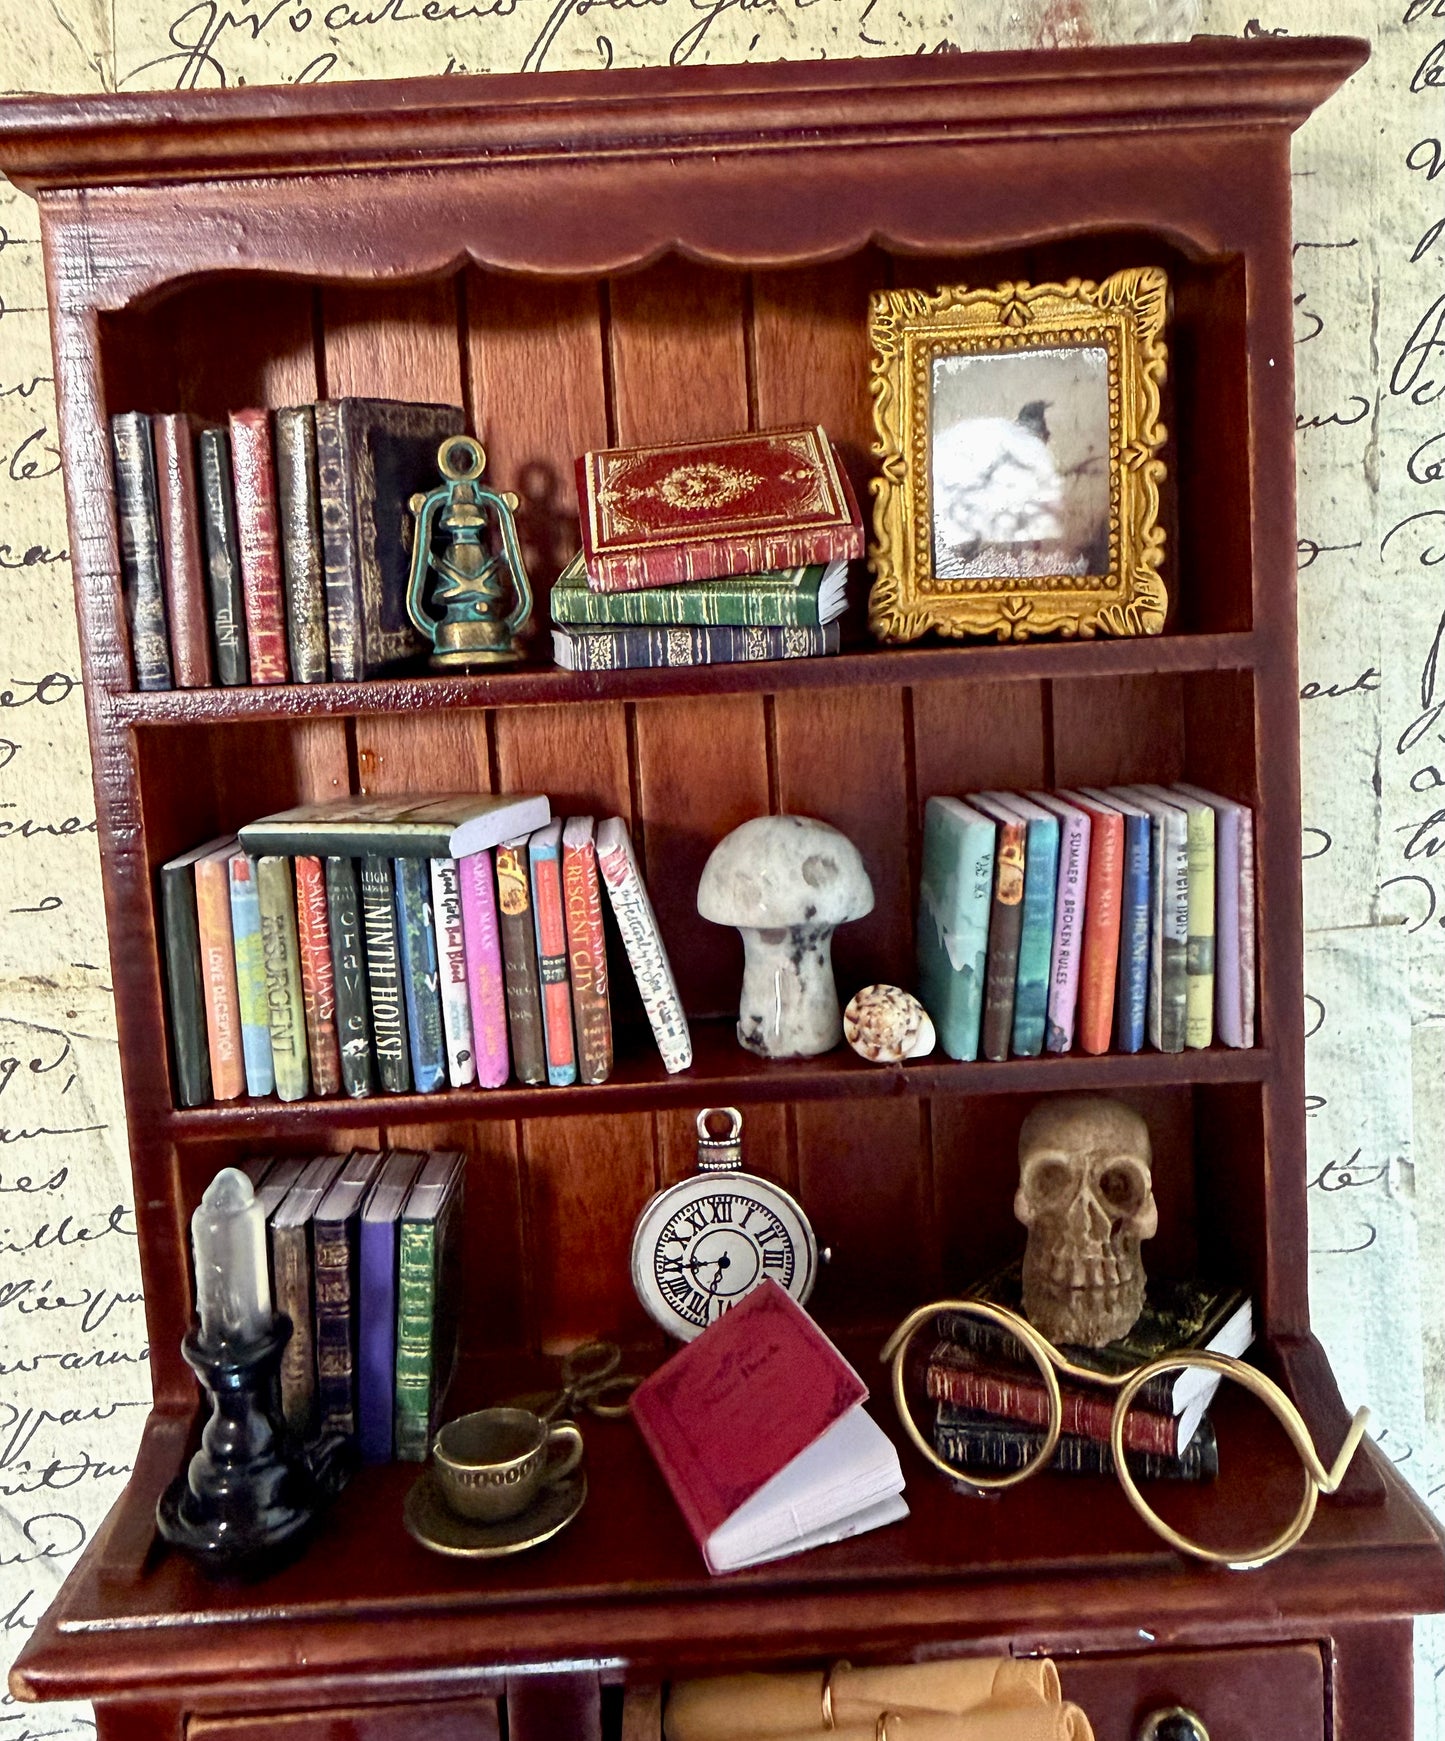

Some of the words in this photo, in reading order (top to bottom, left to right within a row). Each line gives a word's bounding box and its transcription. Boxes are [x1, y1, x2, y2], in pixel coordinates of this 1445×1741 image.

[438, 868, 458, 895] Good
[1067, 832, 1081, 884] SUMMER
[307, 872, 329, 939] SARAH
[1060, 899, 1075, 947] BROKEN
[363, 903, 397, 979] NINTH
[445, 926, 463, 948] Bad
[1132, 903, 1148, 963] THRONE
[208, 947, 226, 983] LOVE
[262, 914, 296, 1057] INSURGENT
[316, 961, 335, 1021] MAAS
[446, 949, 467, 984] Blood
[572, 950, 593, 992] CITY
[1056, 950, 1071, 985] RULES
[213, 985, 234, 1062] DECEPTION
[370, 986, 403, 1060] HOUSE
